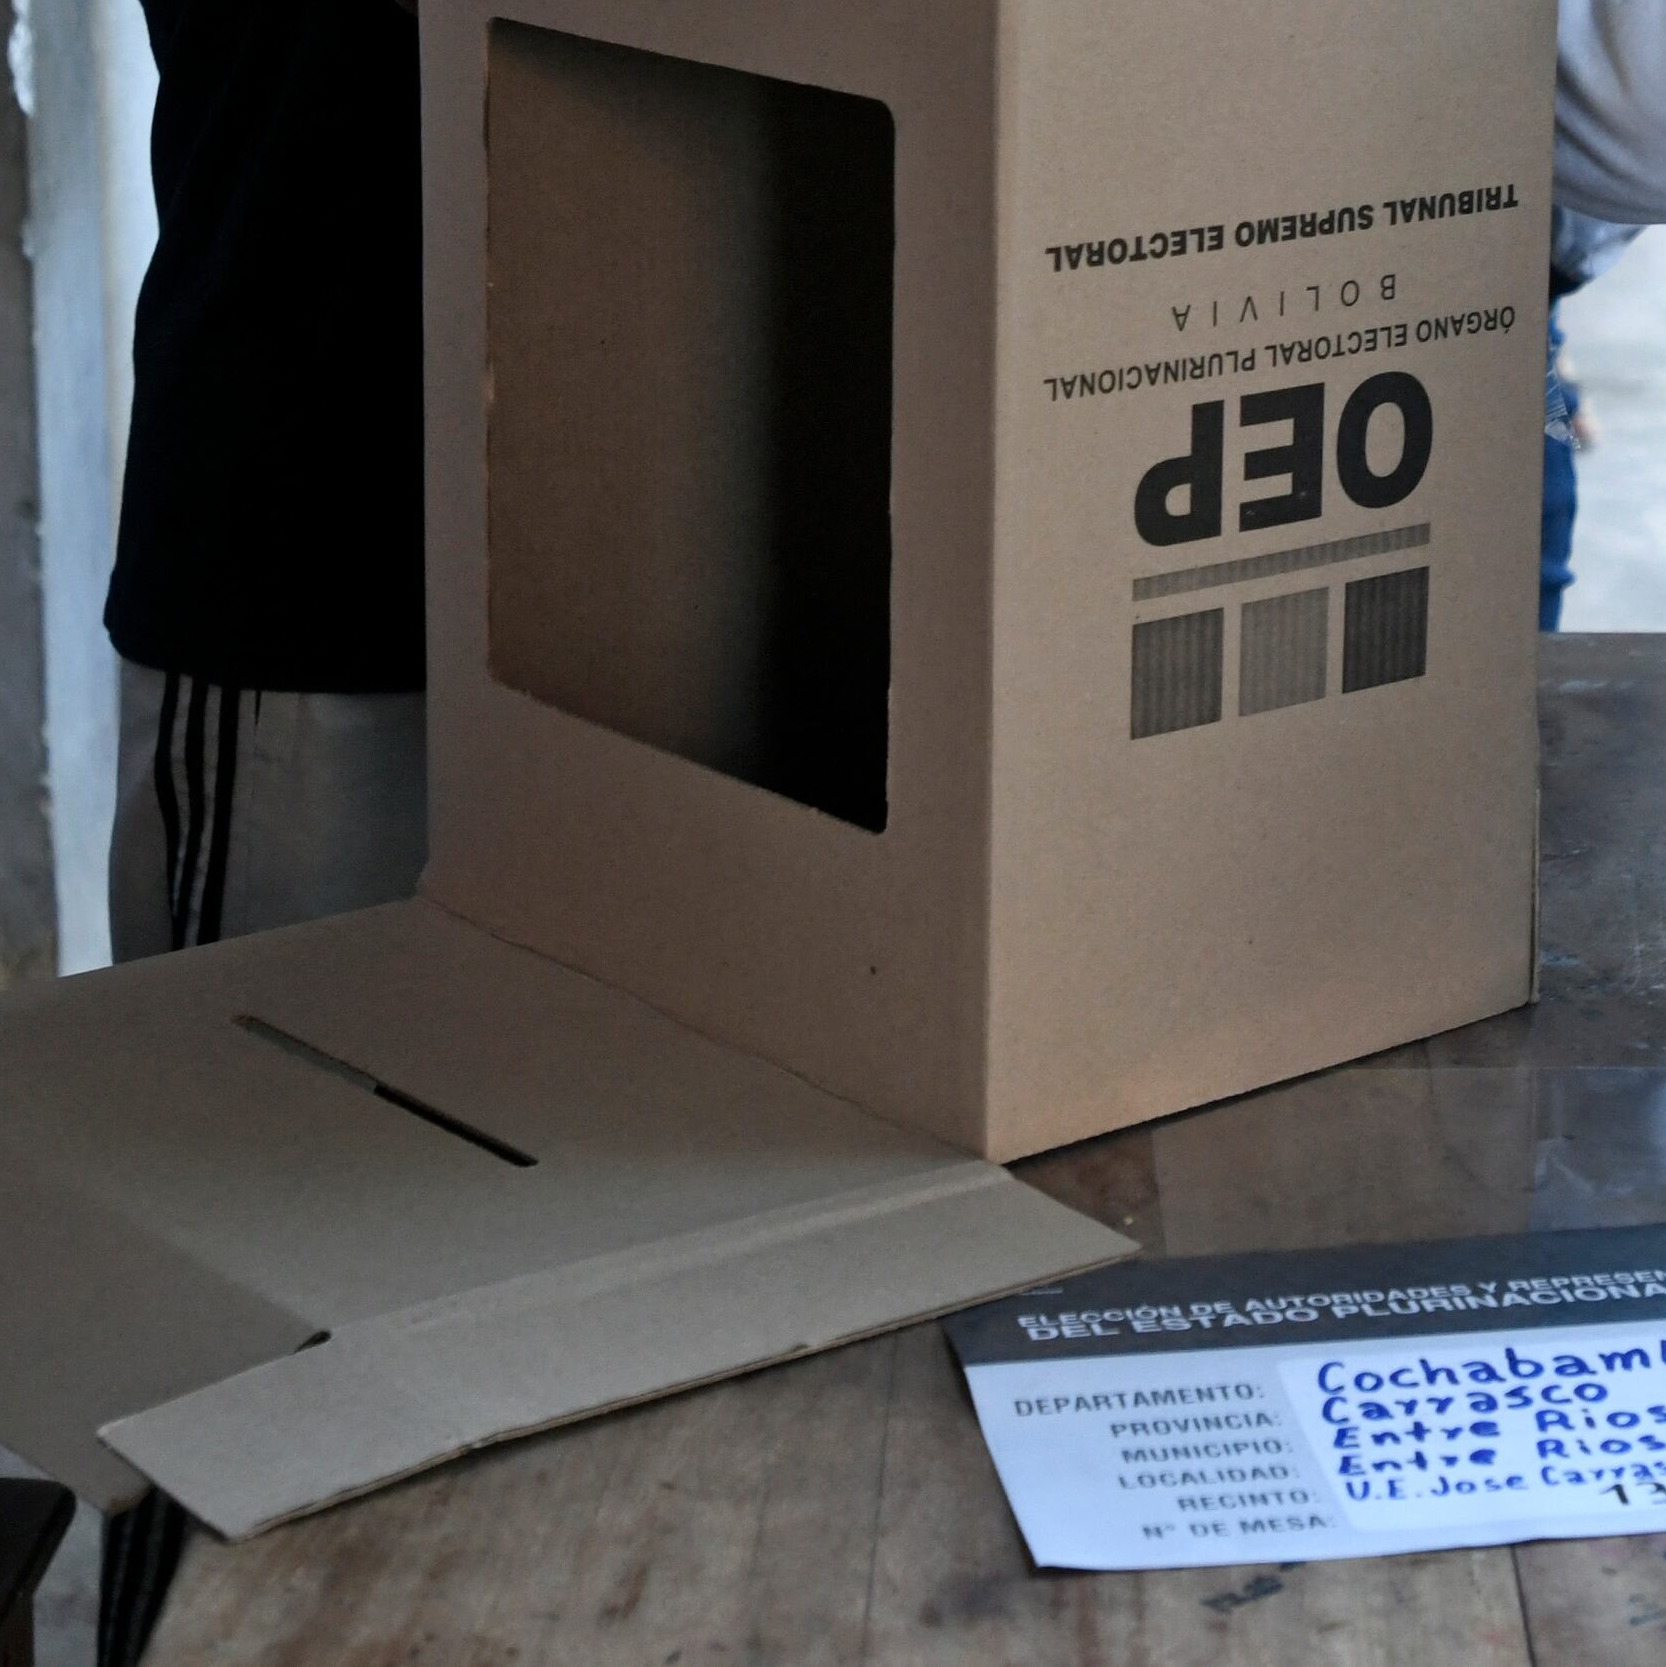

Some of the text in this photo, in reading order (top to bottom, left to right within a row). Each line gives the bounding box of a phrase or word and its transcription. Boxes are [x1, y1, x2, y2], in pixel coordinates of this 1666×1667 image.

[1045, 184, 1519, 272] TRIBUNAL SUPREMO ELECTORAL
[1172, 274, 1397, 332] BOLIVIA
[1044, 305, 1516, 402] ÓRGANO ELECTORAL PLURINACIONAL
[1134, 370, 1434, 547] OEP
[1017, 1303, 1182, 1328] ELECCIÓN
[1190, 1300, 1233, 1317] DE
[1245, 1284, 1472, 1312] AUTORIDADES
[1477, 1280, 1499, 1294] Y
[1028, 1322, 1120, 1341] DEL
[1134, 1308, 1320, 1334] ESTADO
[1014, 1383, 1264, 1417] DEPARTAMENTO:
[1322, 1382, 1608, 1425] Carrasco
[1110, 1412, 1281, 1438] PROVINCIA:
[1333, 1420, 1501, 1450] Entre
[1121, 1439, 1294, 1464] MUNICIPIO:
[1338, 1449, 1498, 1477] Entre
[1118, 1465, 1300, 1490] LOCALIDAD:
[1431, 1474, 1529, 1498] Jose
[1177, 1490, 1321, 1513] RECINTO:
[1190, 1519, 1227, 1538] DE
[1239, 1514, 1336, 1535] MESA:
